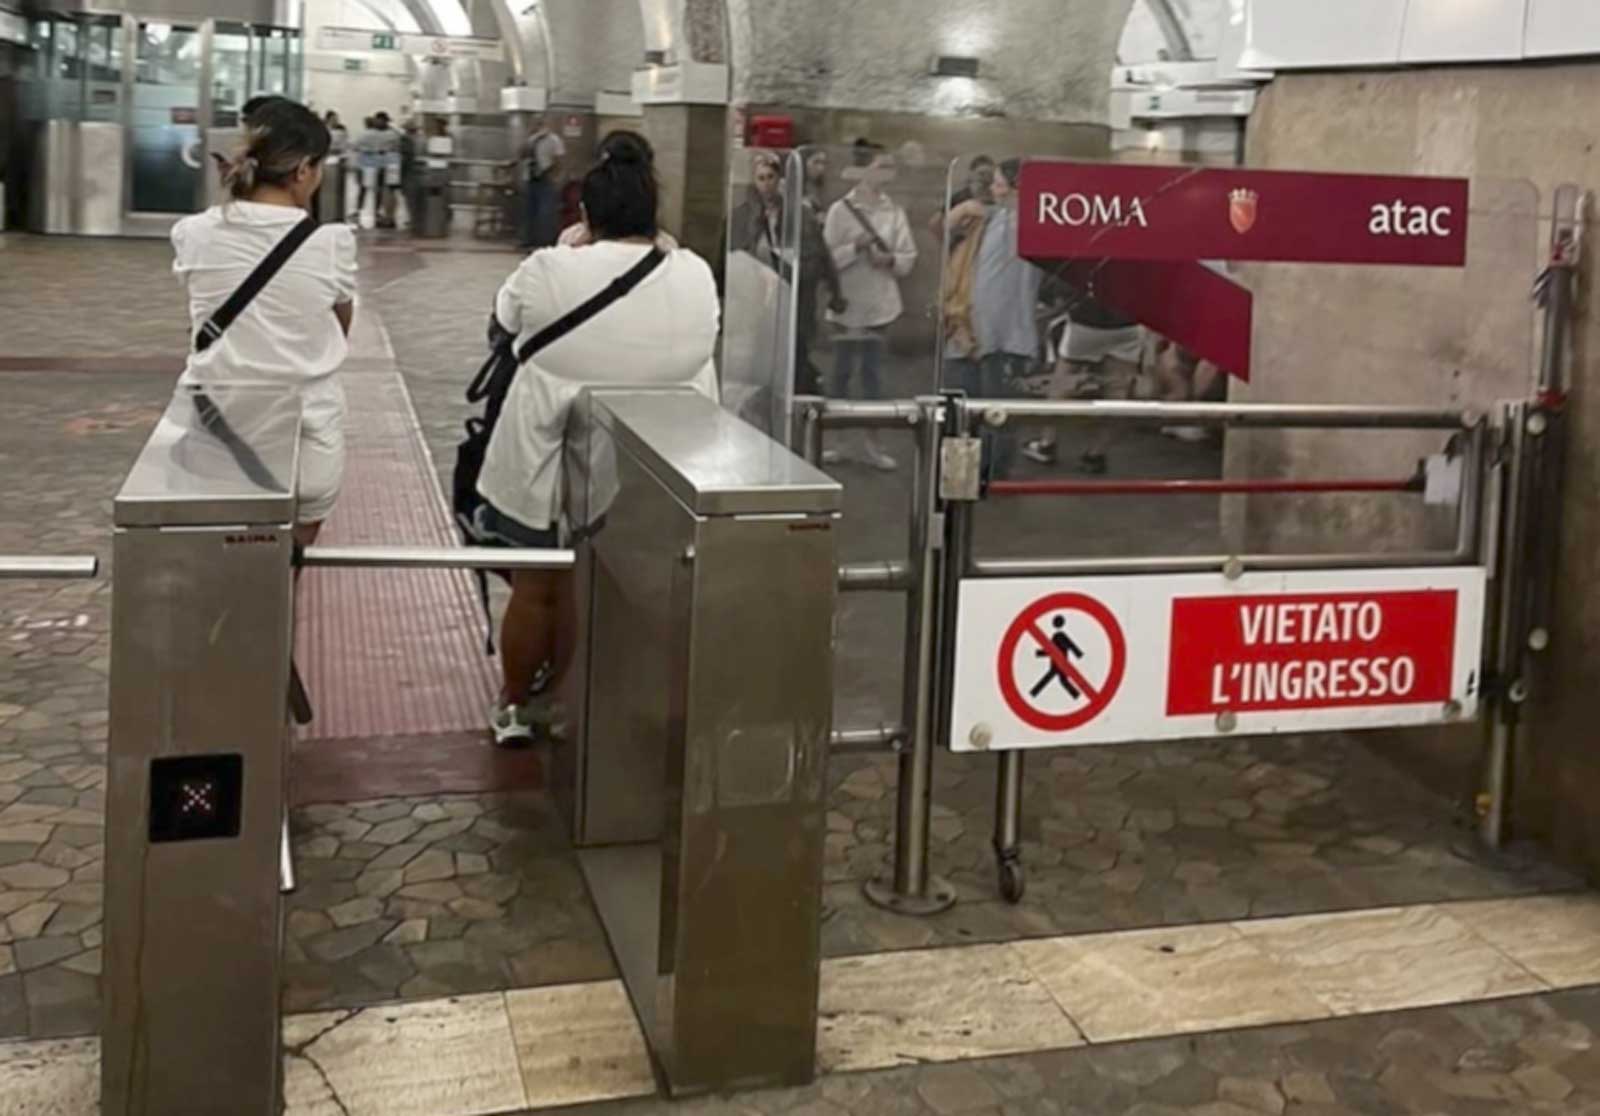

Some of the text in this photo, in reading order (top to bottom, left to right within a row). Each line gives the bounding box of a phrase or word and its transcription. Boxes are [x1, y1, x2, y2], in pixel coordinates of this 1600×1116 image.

[1038, 193, 1147, 227] ROMA
[1369, 199, 1451, 236] atac
[1240, 601, 1382, 645] VIETATO
[1211, 655, 1414, 704] L'INGRESSO
